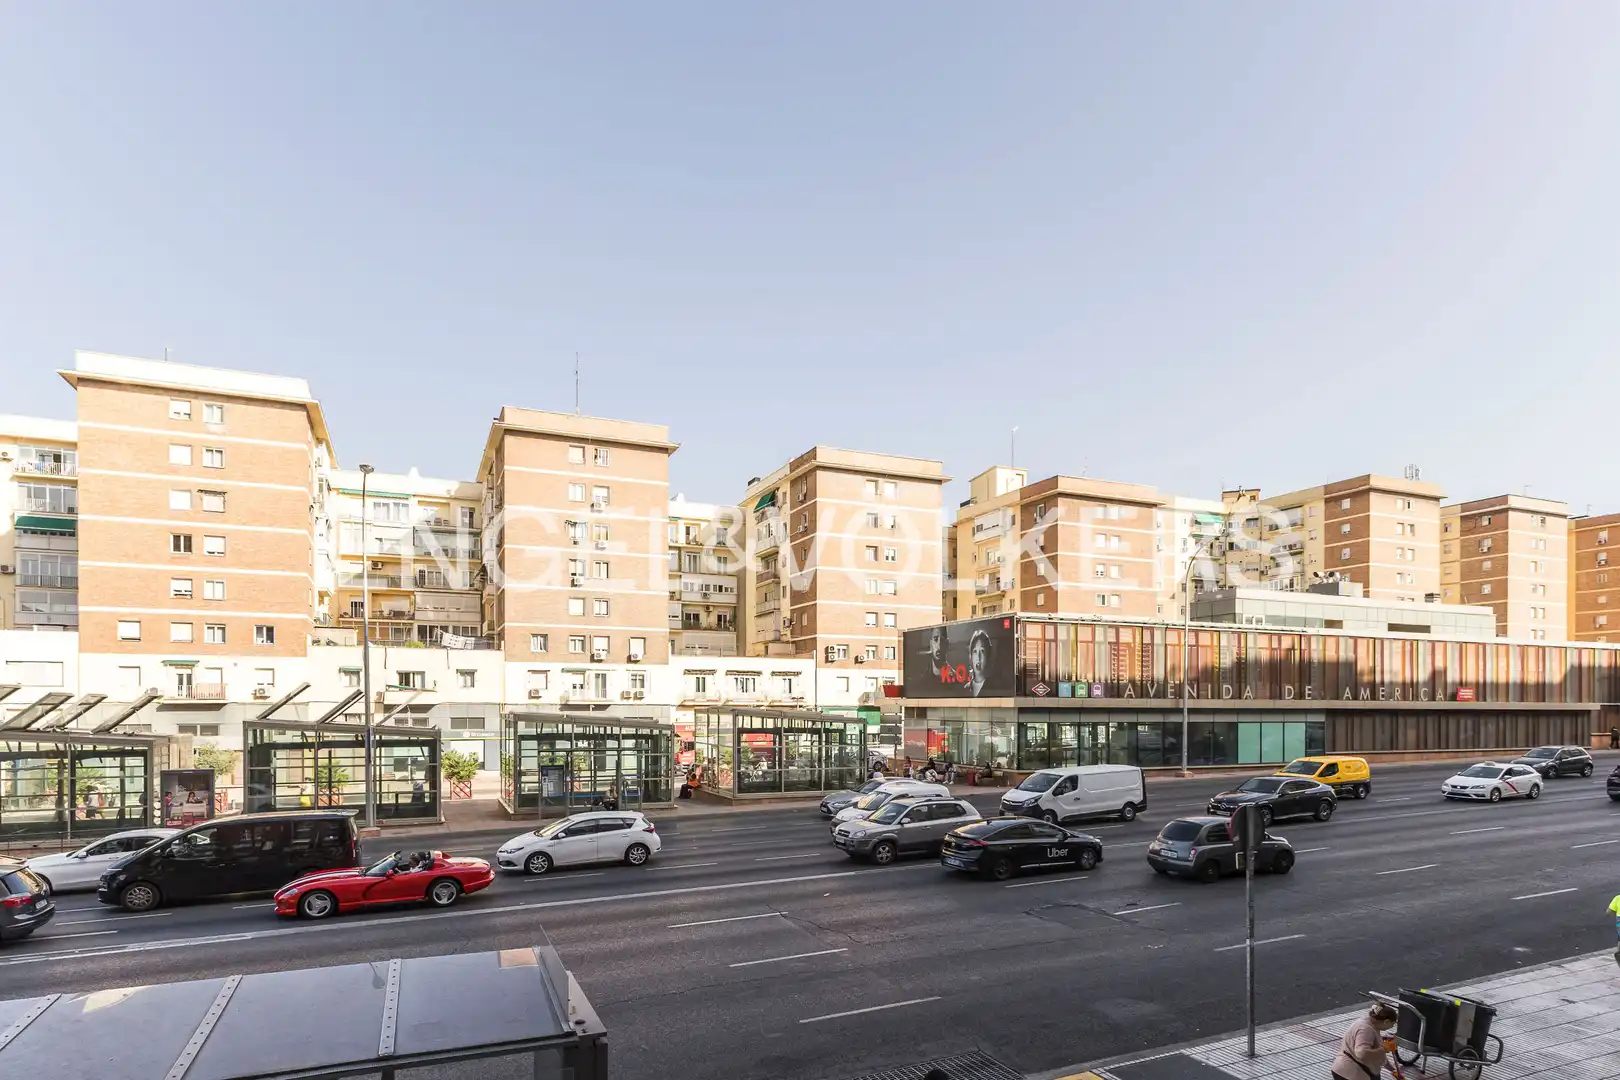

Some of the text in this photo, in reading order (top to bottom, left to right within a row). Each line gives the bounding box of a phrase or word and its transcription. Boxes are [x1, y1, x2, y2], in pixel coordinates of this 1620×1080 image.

[1124, 683, 1254, 699] AVENIDA
[1285, 685, 1313, 700] DE
[1047, 847, 1068, 858] Uber
